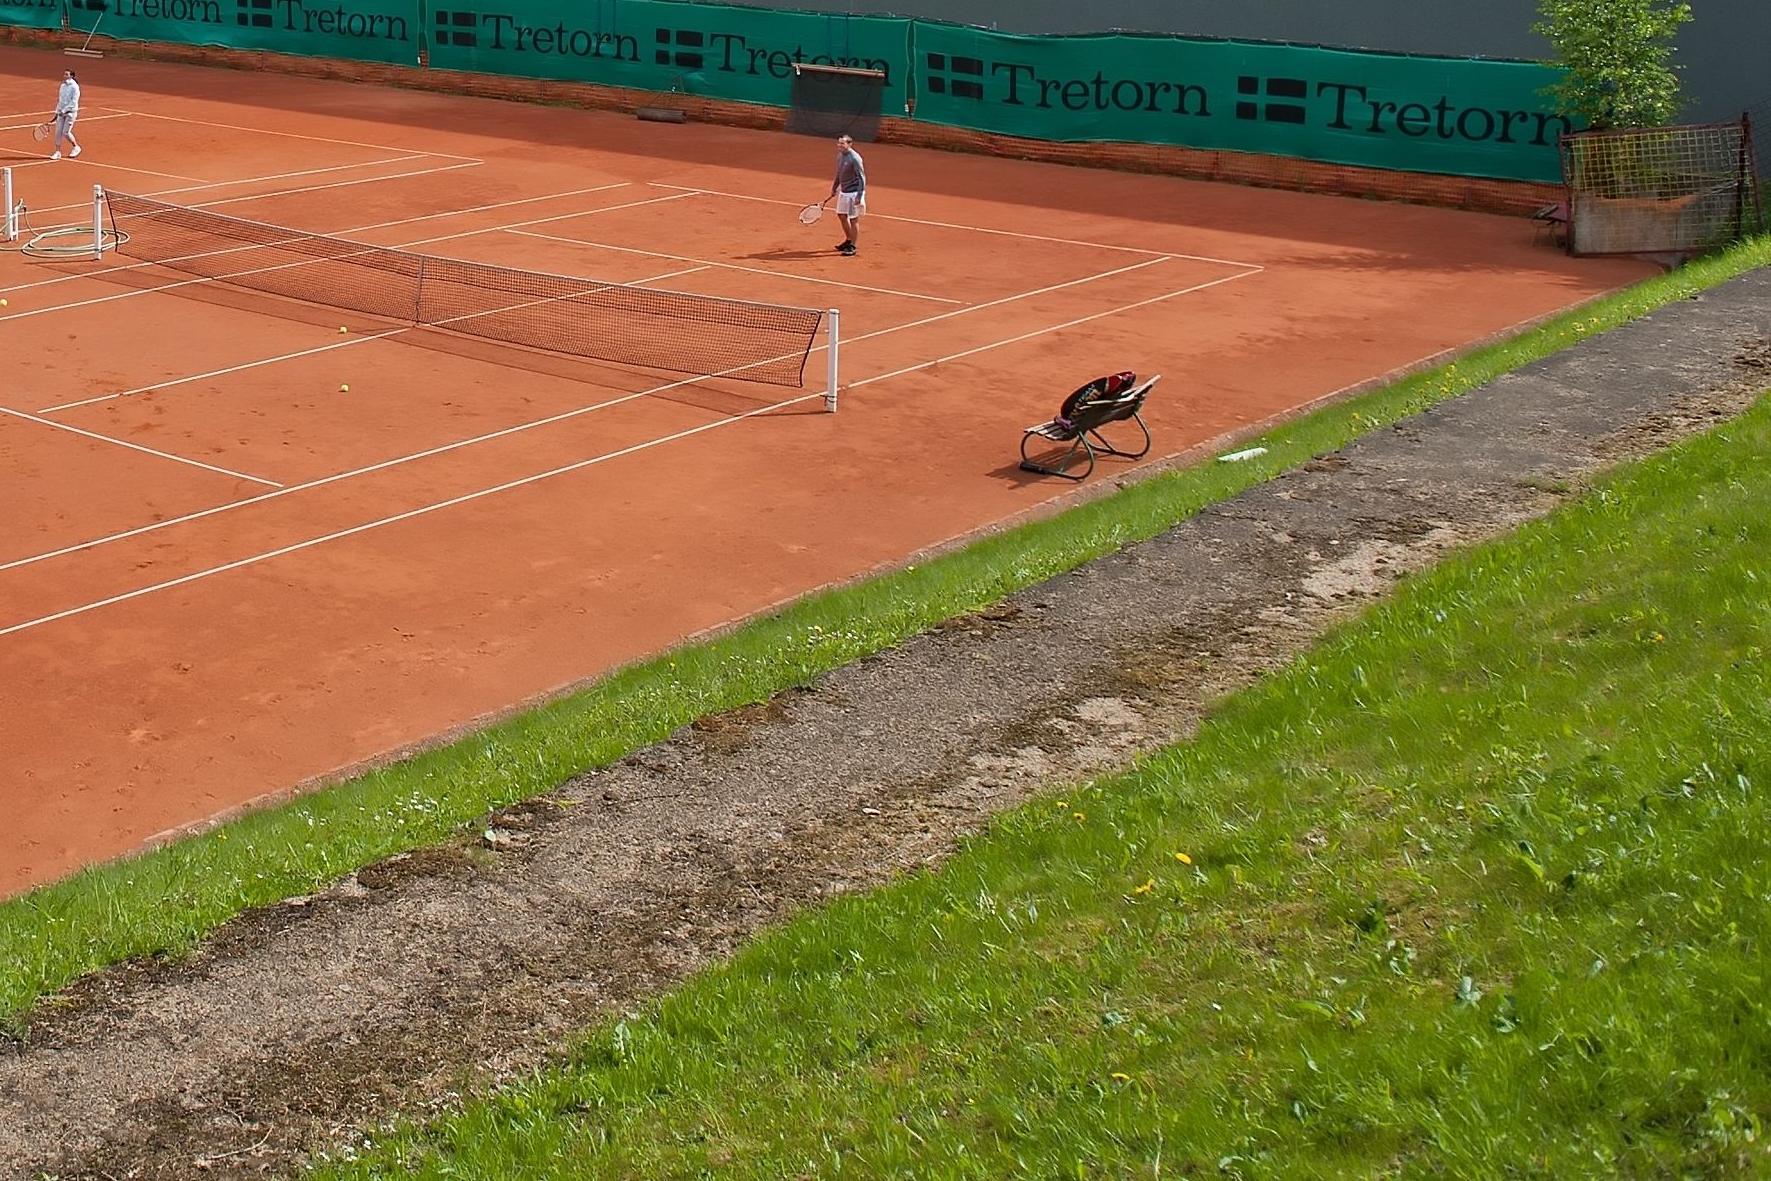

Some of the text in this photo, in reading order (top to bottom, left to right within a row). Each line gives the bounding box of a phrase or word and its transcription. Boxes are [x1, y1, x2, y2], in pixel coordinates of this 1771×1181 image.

[482, 13, 641, 62] Tretorn
[991, 62, 1212, 117] Tretorn
[1316, 81, 1571, 148] Tretorn
